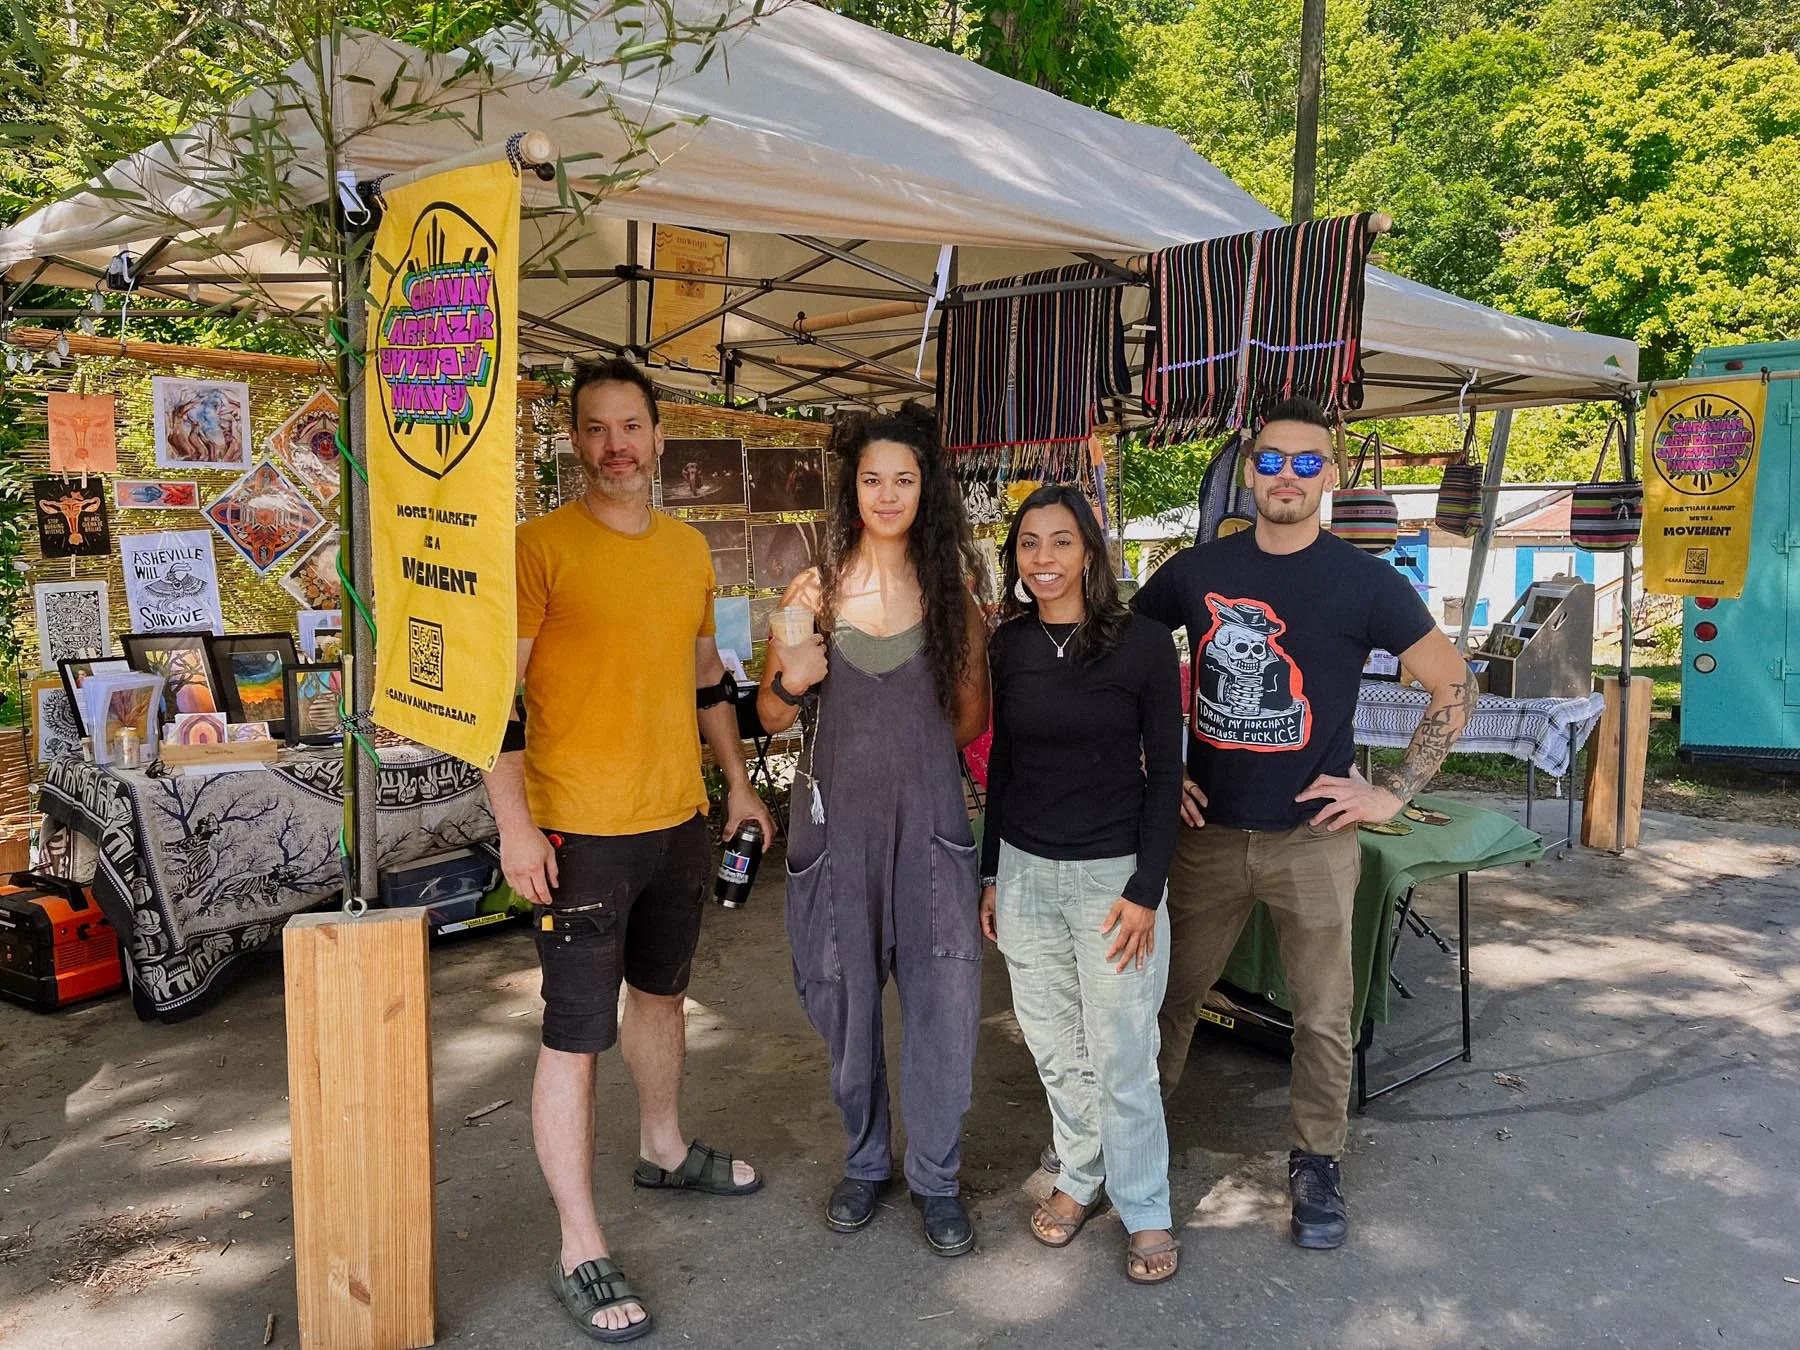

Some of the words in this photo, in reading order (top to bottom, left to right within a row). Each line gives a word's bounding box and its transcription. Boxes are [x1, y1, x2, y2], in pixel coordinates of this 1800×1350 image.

[1663, 526, 1732, 537] MOVEMENT
[134, 548, 204, 566] ASHEVILLE
[134, 565, 161, 580] WILL
[140, 606, 206, 630] SURVIVE
[1203, 705, 1226, 728] DRINK
[1228, 718, 1242, 730] MY
[1244, 716, 1295, 730] HORCHATA
[1216, 728, 1239, 740] CAUSE
[1243, 731, 1273, 743] FUCK
[1274, 725, 1299, 744] ICE
